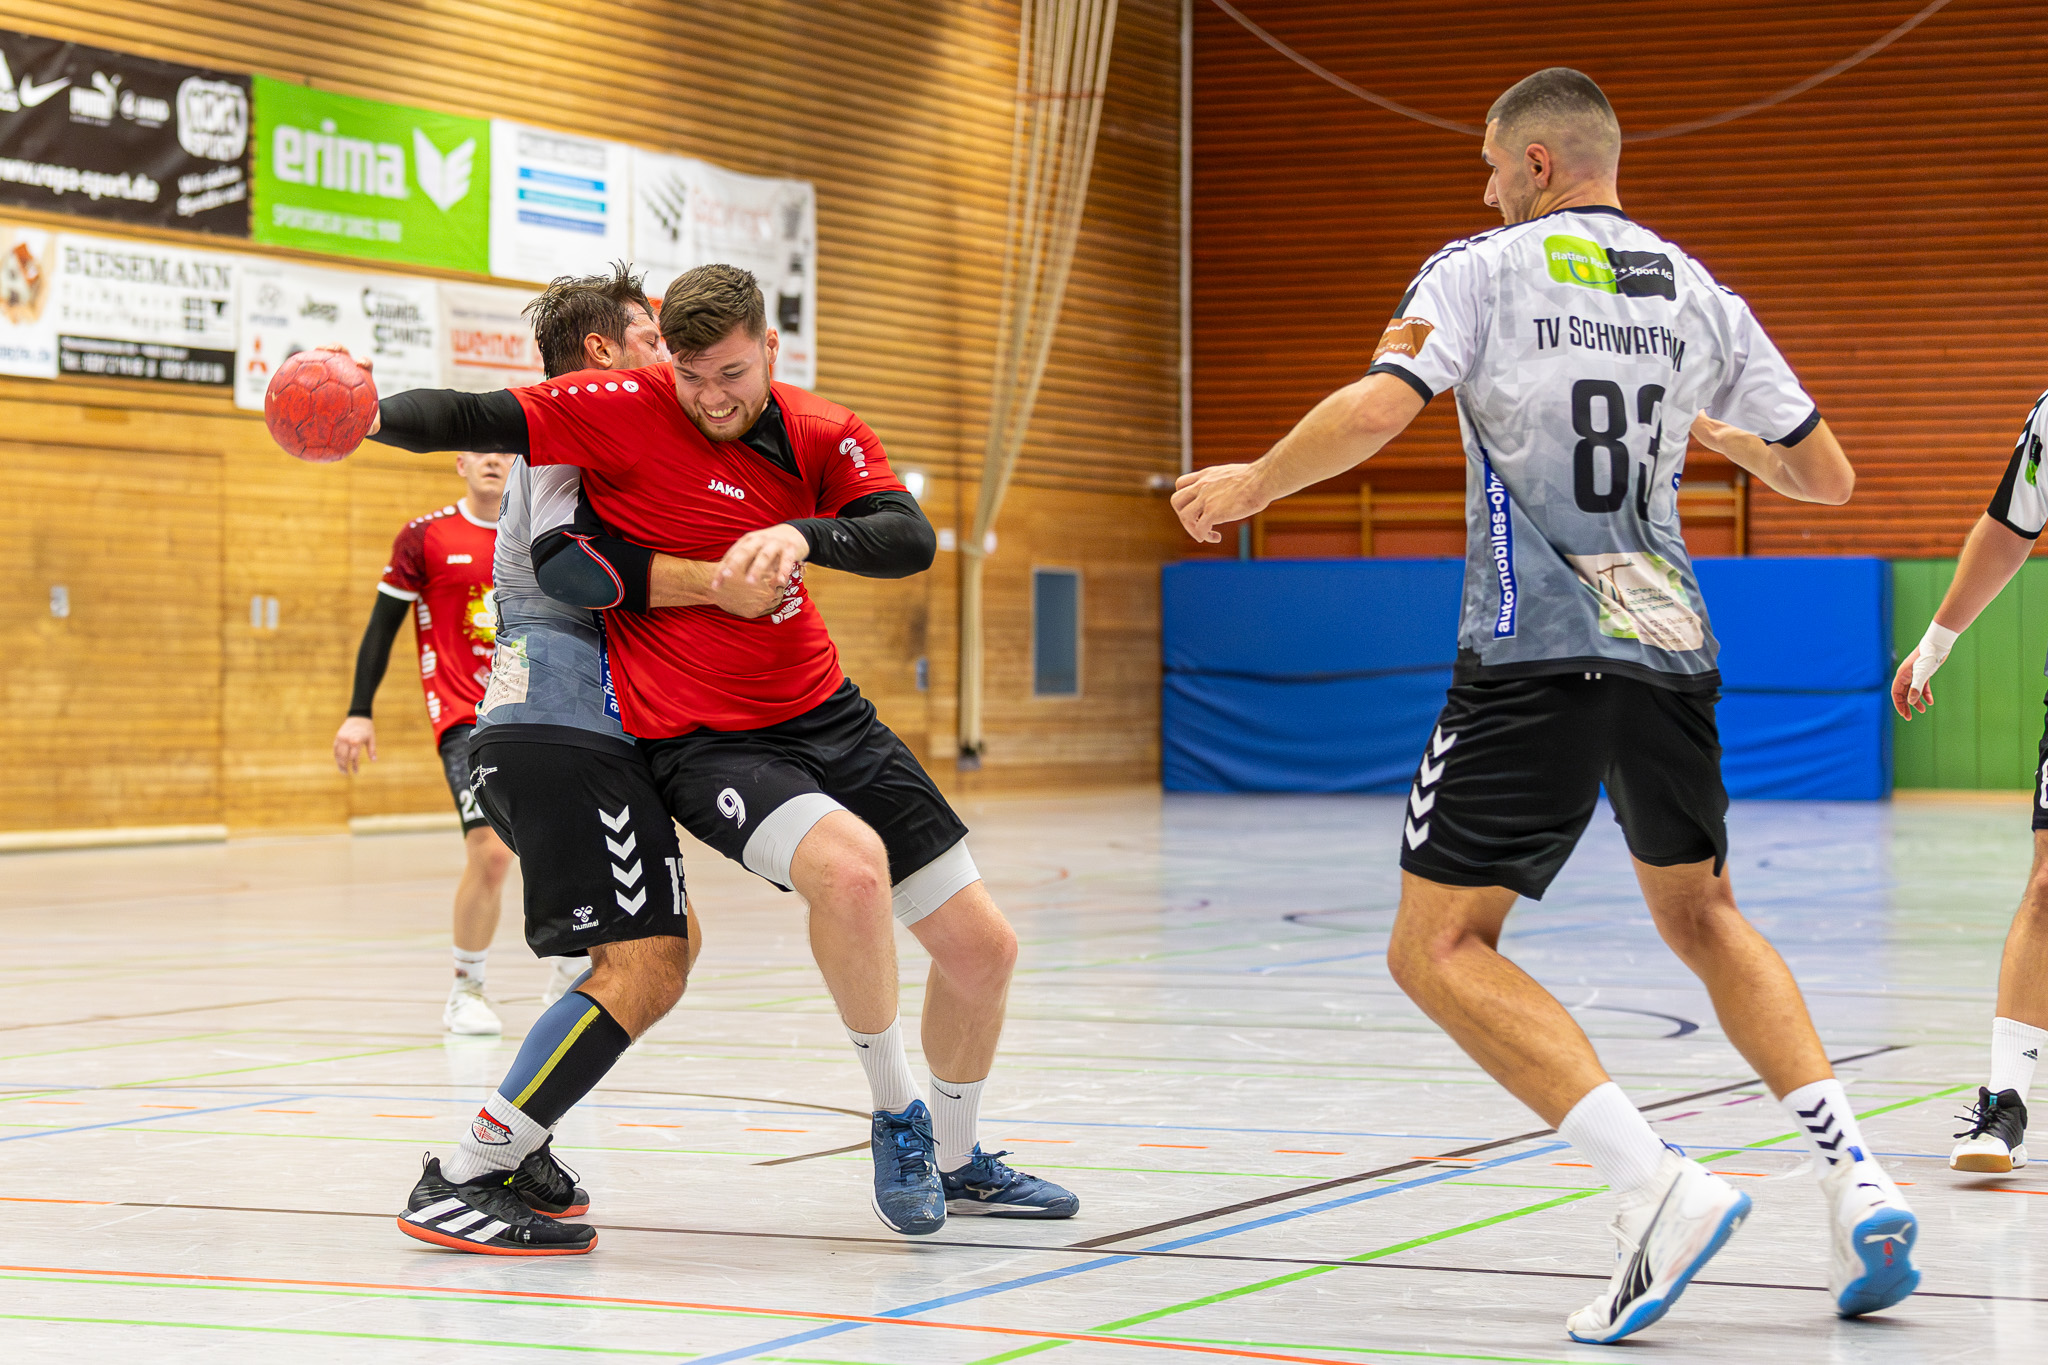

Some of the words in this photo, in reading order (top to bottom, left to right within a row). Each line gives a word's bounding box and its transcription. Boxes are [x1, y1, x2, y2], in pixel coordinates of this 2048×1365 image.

[273, 118, 405, 199] erima
[64, 246, 232, 292] BIESEMANN
[1551, 251, 1588, 264] Flatten
[1628, 265, 1660, 277] Sport
[1533, 316, 1560, 350] TV
[708, 479, 745, 500] JAKO
[717, 787, 746, 829] 9
[573, 920, 599, 931] hummel
